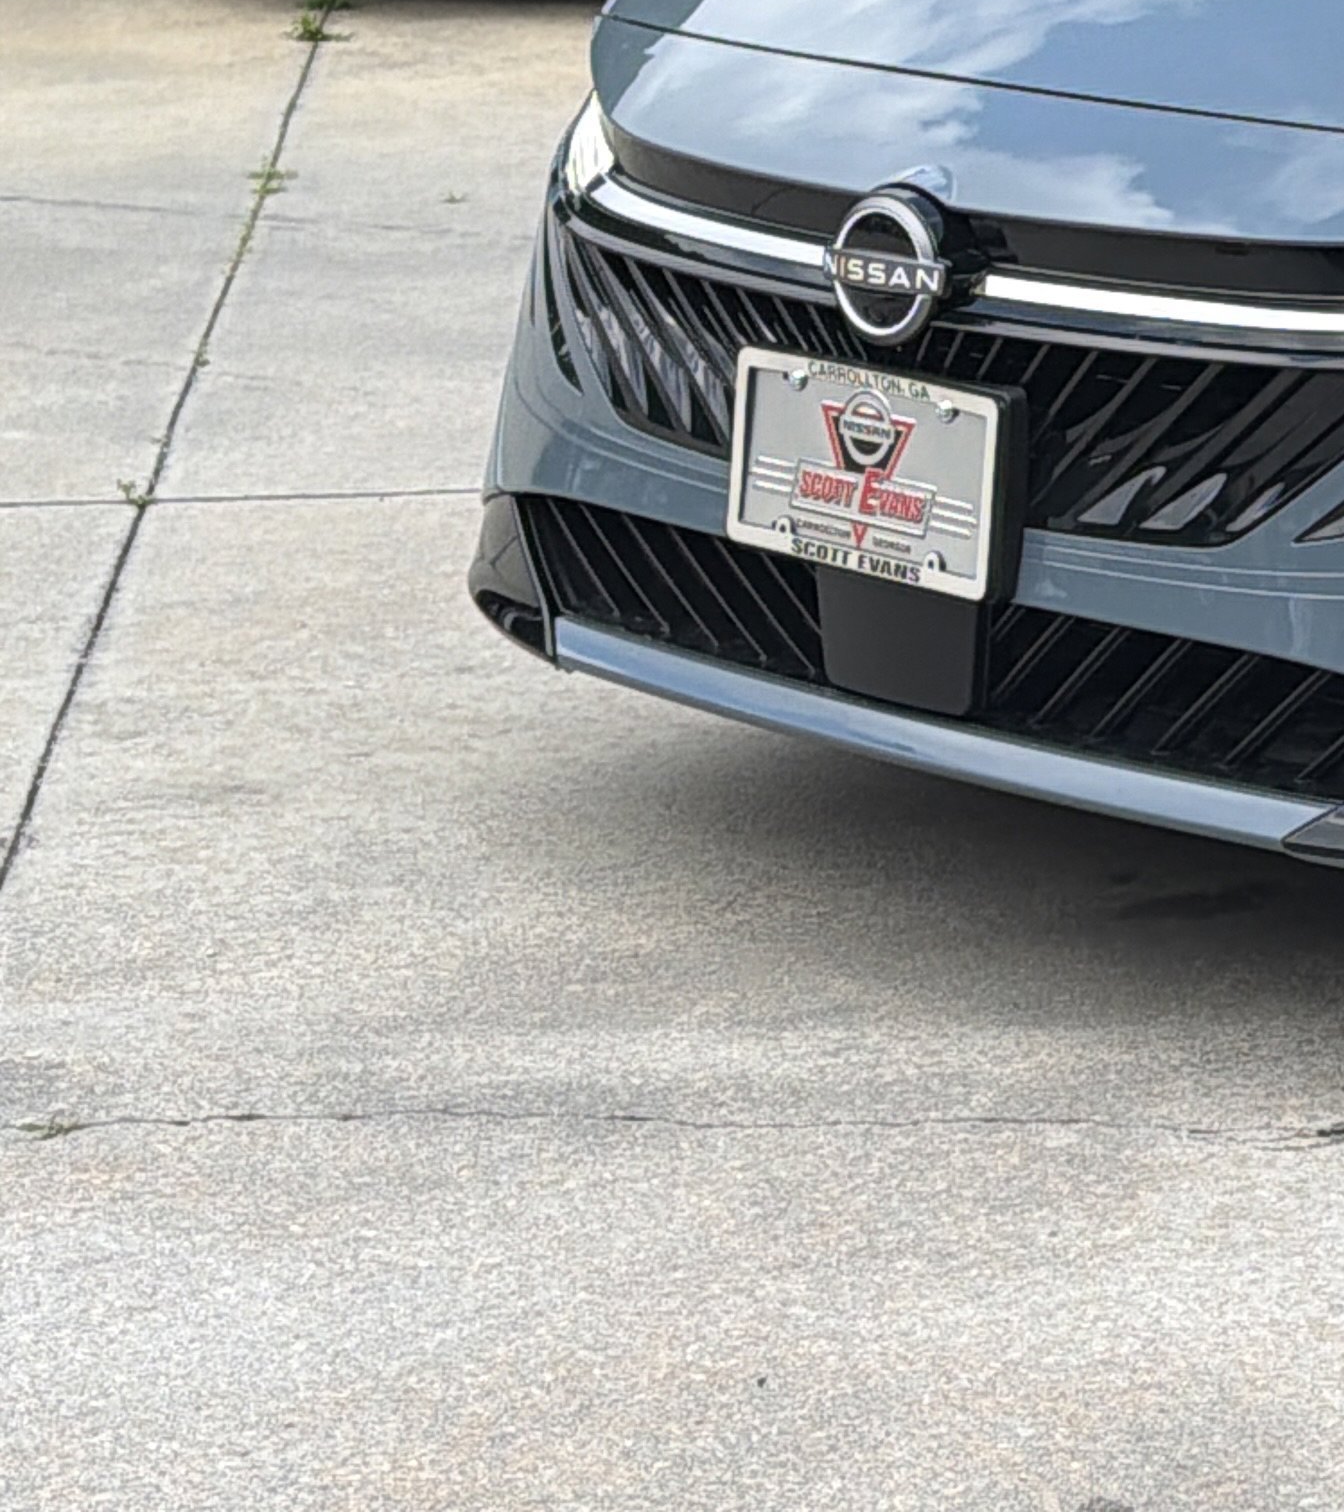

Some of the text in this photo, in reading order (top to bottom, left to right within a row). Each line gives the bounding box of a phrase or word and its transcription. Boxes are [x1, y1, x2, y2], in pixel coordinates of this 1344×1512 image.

[824, 252, 939, 291] NISSAN
[907, 381, 931, 400] GA
[843, 419, 892, 439] NISSAN
[800, 470, 858, 509] SCOTT
[791, 537, 921, 584] SCOTT EVANS
